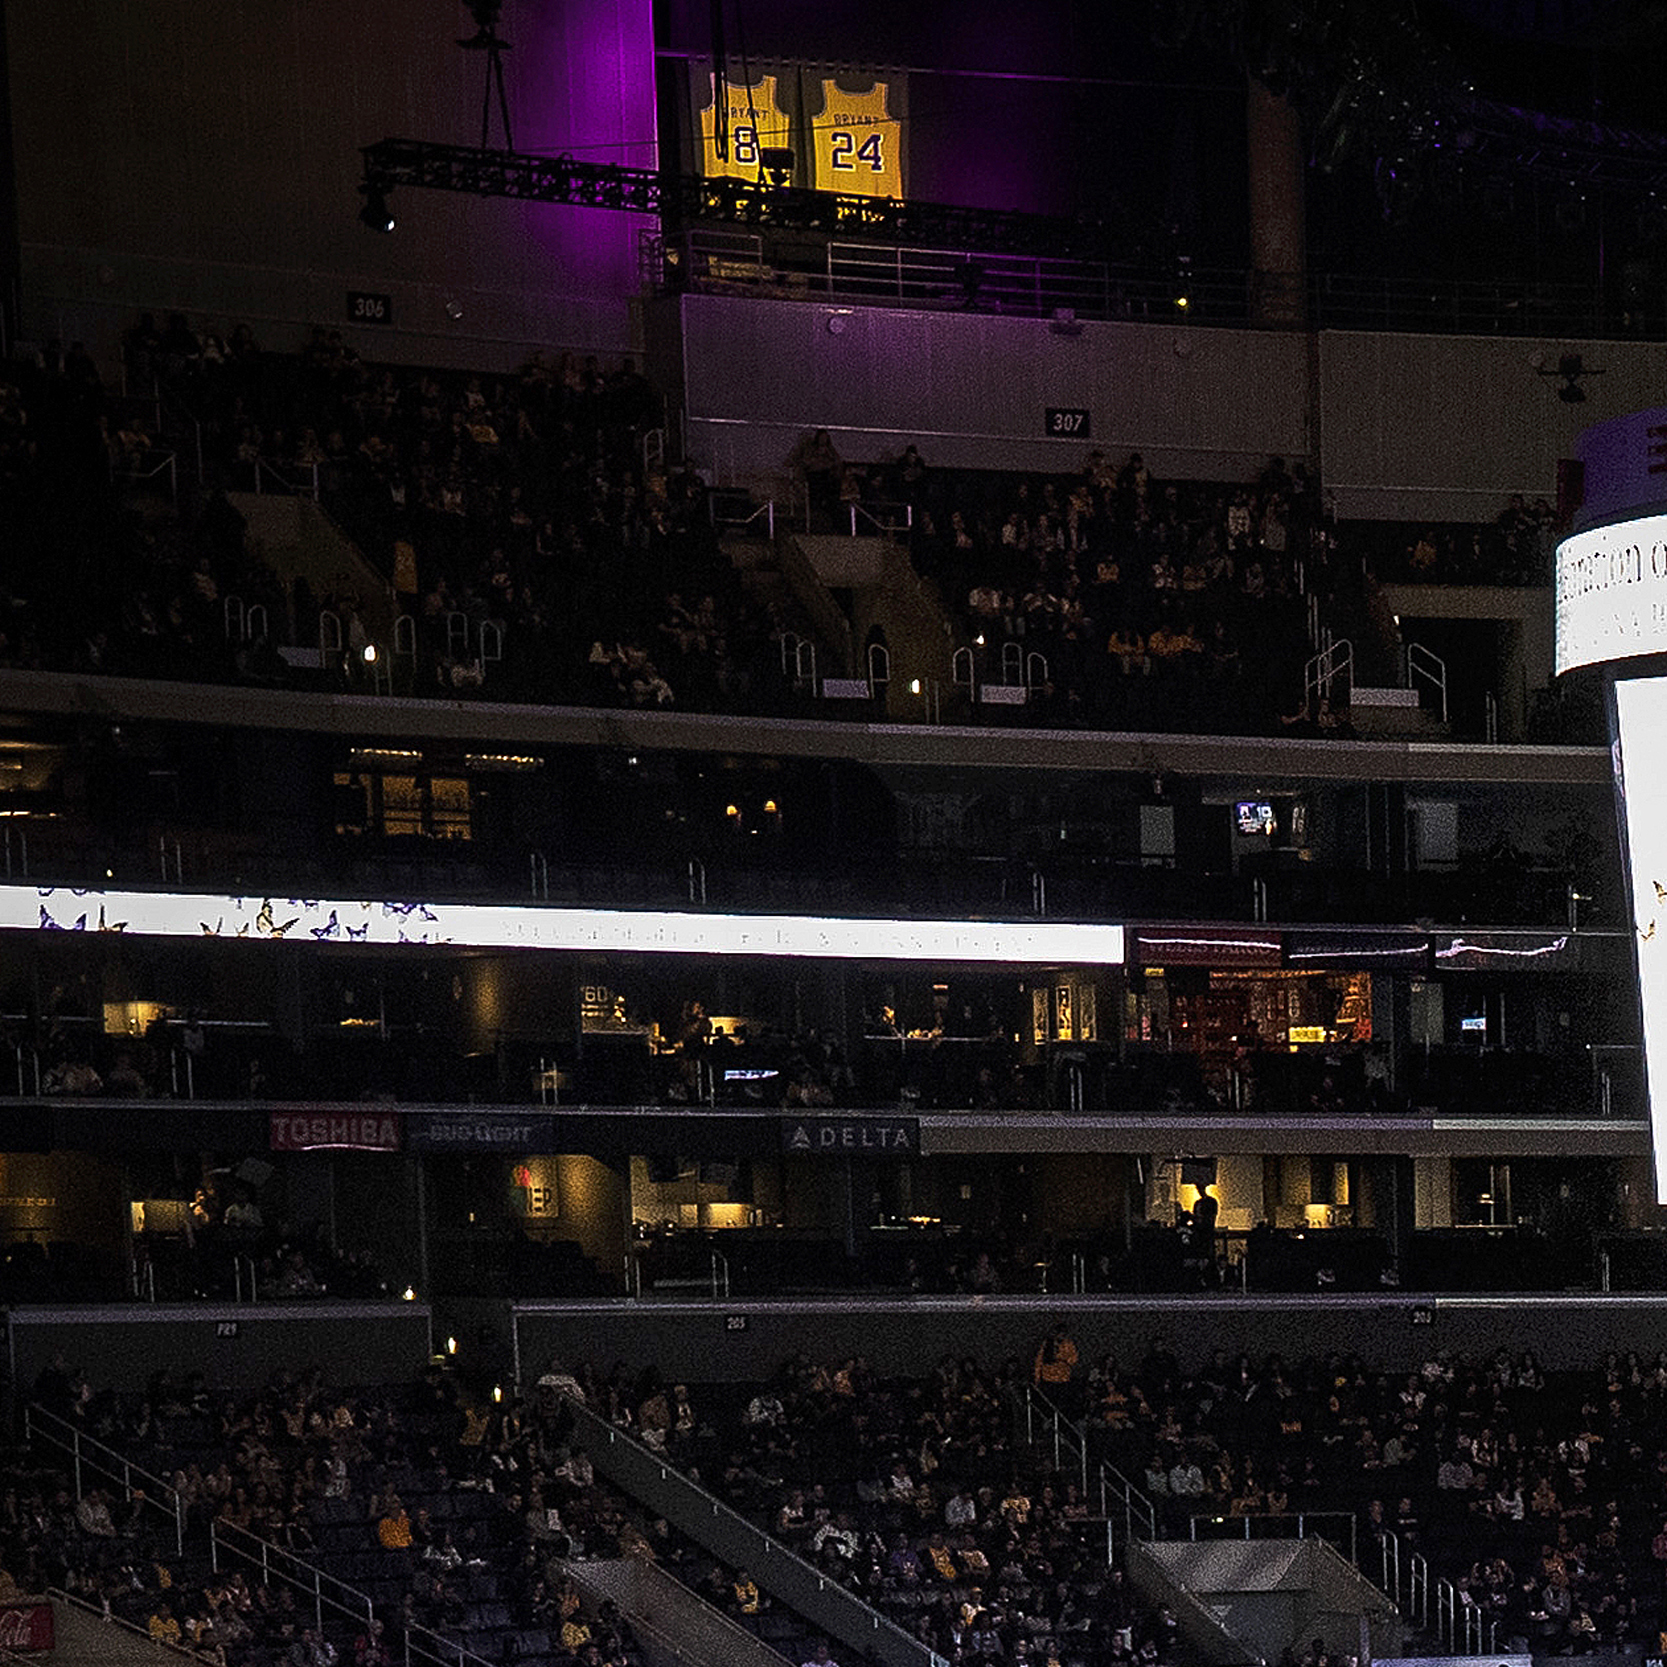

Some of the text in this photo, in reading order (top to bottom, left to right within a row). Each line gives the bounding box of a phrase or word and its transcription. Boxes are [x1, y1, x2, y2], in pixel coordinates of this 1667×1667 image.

[726, 107, 769, 121] RYANT
[834, 113, 880, 128] BRYANT
[733, 126, 757, 163] 8
[831, 132, 885, 171] 24
[355, 297, 385, 319] 306
[1053, 413, 1084, 432] 307
[274, 1118, 397, 1144] TOSHIBA
[820, 1128, 910, 1147] DELTA
